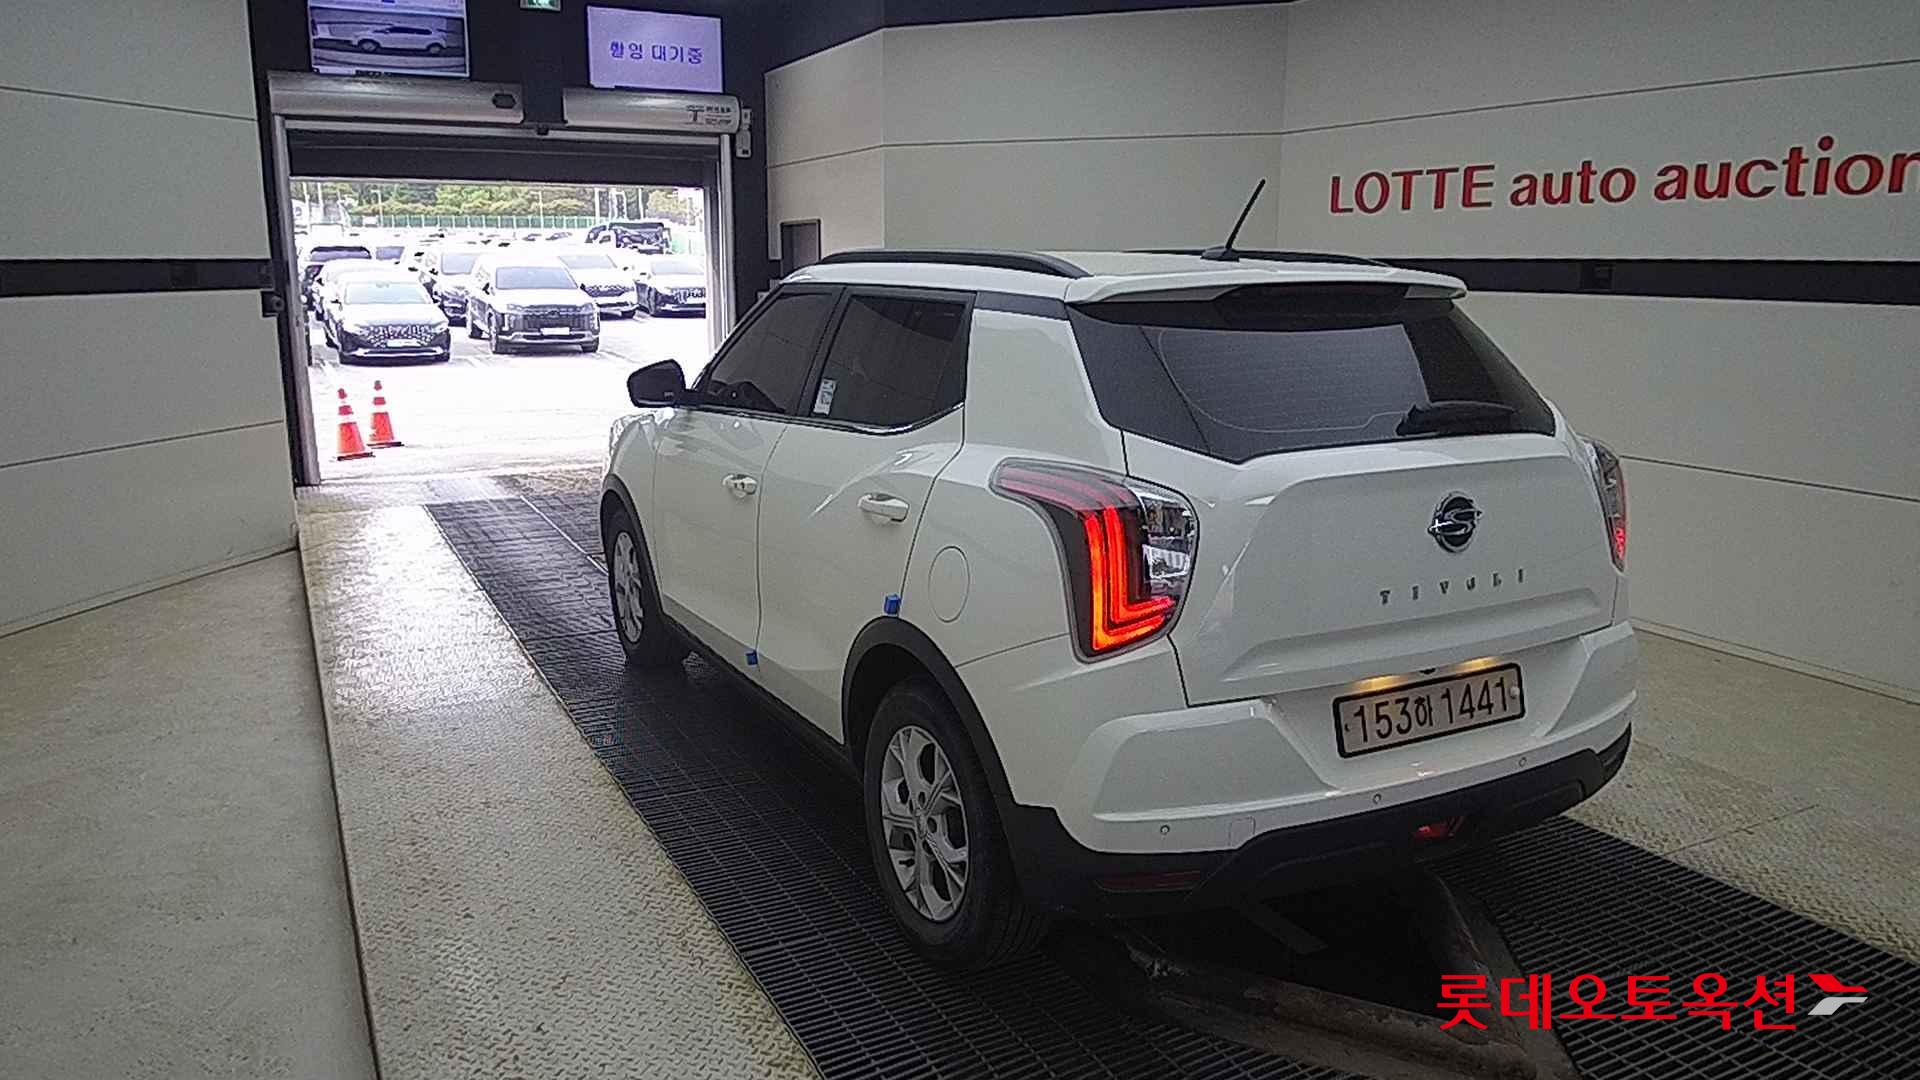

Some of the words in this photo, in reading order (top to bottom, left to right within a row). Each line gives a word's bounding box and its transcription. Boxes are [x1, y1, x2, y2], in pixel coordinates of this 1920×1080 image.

[652, 45, 703, 65] 대기중
[1330, 164, 1495, 214] LOTTE
[1509, 160, 1636, 207] auto
[1654, 135, 1920, 201] auction
[1379, 568, 1524, 605] TIVOLI
[1353, 695, 1434, 743] 153하
[1441, 676, 1508, 725] 1441
